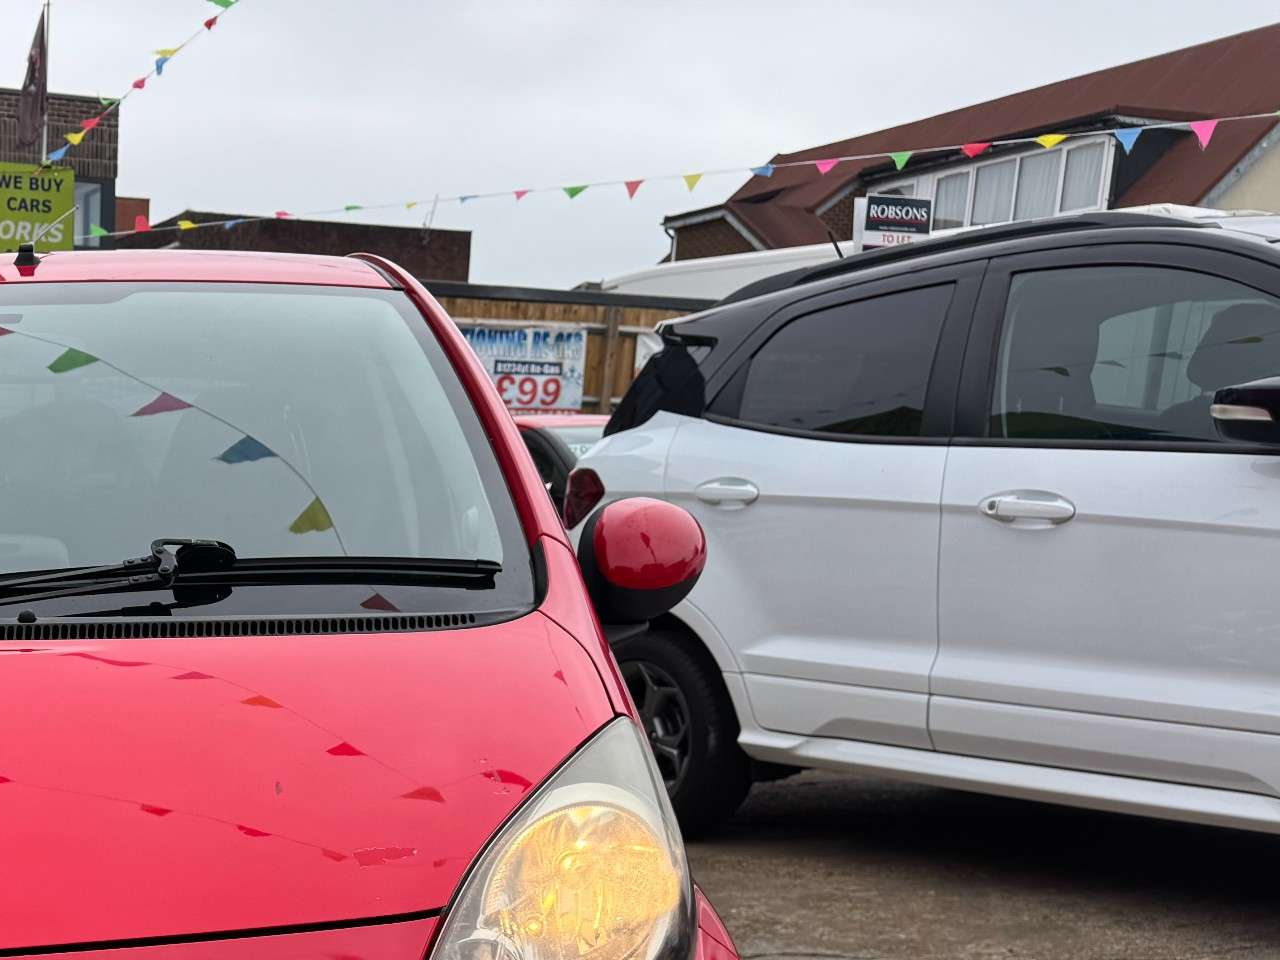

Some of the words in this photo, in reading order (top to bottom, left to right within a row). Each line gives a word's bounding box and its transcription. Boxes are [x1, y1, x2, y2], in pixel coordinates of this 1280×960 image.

[28, 176, 64, 192] BUY
[6, 196, 52, 213] CARS
[870, 204, 928, 221] ROBSONS
[882, 234, 894, 244] TO
[496, 374, 562, 406] £99
